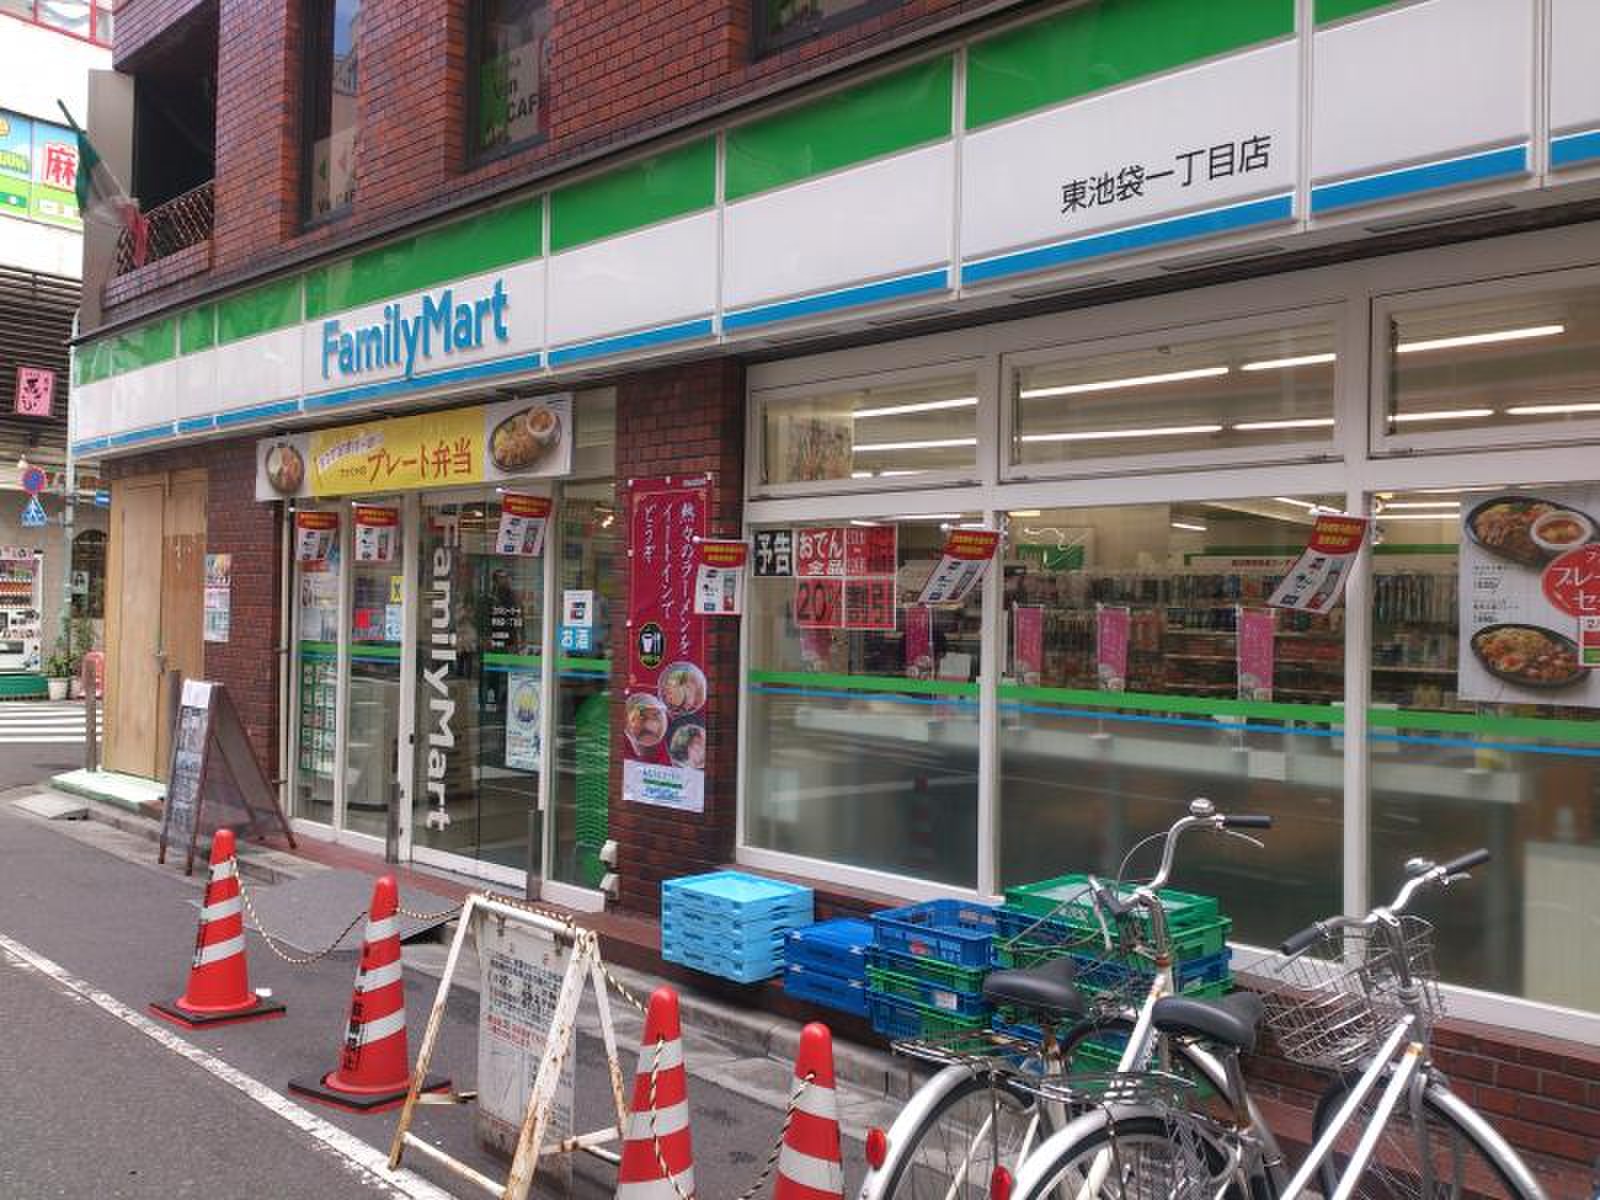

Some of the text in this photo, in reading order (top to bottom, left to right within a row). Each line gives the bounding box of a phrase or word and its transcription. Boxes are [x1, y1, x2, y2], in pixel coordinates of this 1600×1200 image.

[1061, 135, 1272, 214] 東池袋一丁目店
[321, 277, 508, 380] FamilyMart
[367, 437, 472, 486] プレート弁当
[755, 533, 791, 575] 予告
[799, 530, 843, 560] おでん
[424, 510, 460, 832] FamilyMart
